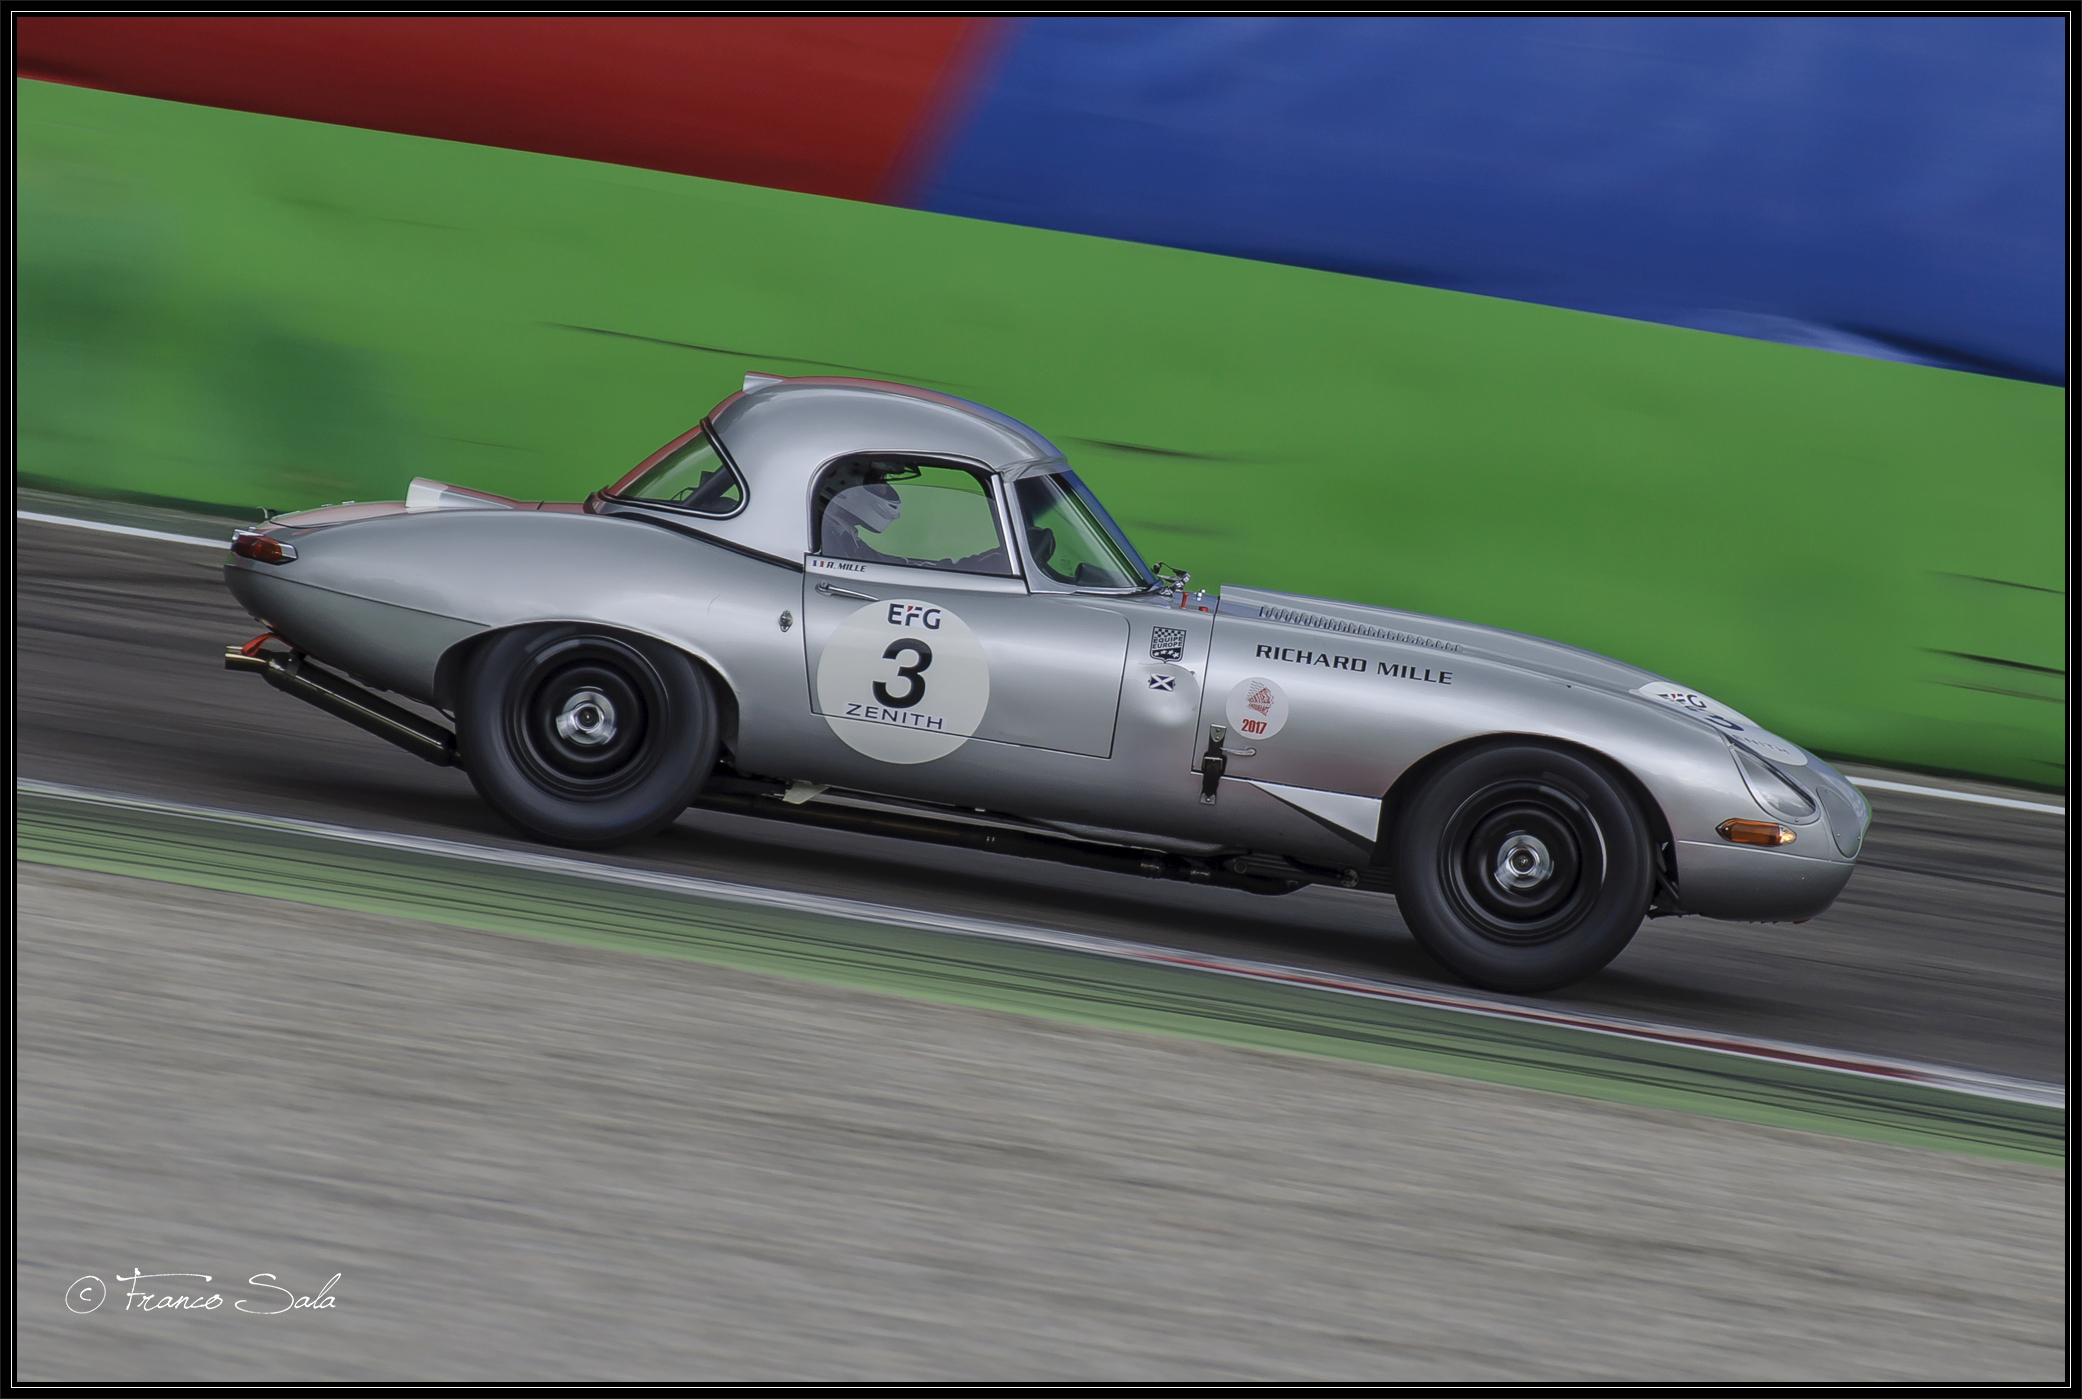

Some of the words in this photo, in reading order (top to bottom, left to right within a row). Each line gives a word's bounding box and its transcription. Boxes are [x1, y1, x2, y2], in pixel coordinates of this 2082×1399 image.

[837, 562, 867, 573] MILLE
[887, 603, 942, 630] EFG
[1152, 641, 1183, 649] EUROPE
[1153, 634, 1184, 644] EQUIPE
[872, 637, 933, 709] 3
[1255, 644, 1368, 673] RICHARD
[1376, 661, 1454, 685] MILLE
[845, 703, 944, 730] ZENITH
[1241, 718, 1268, 735] 2017
